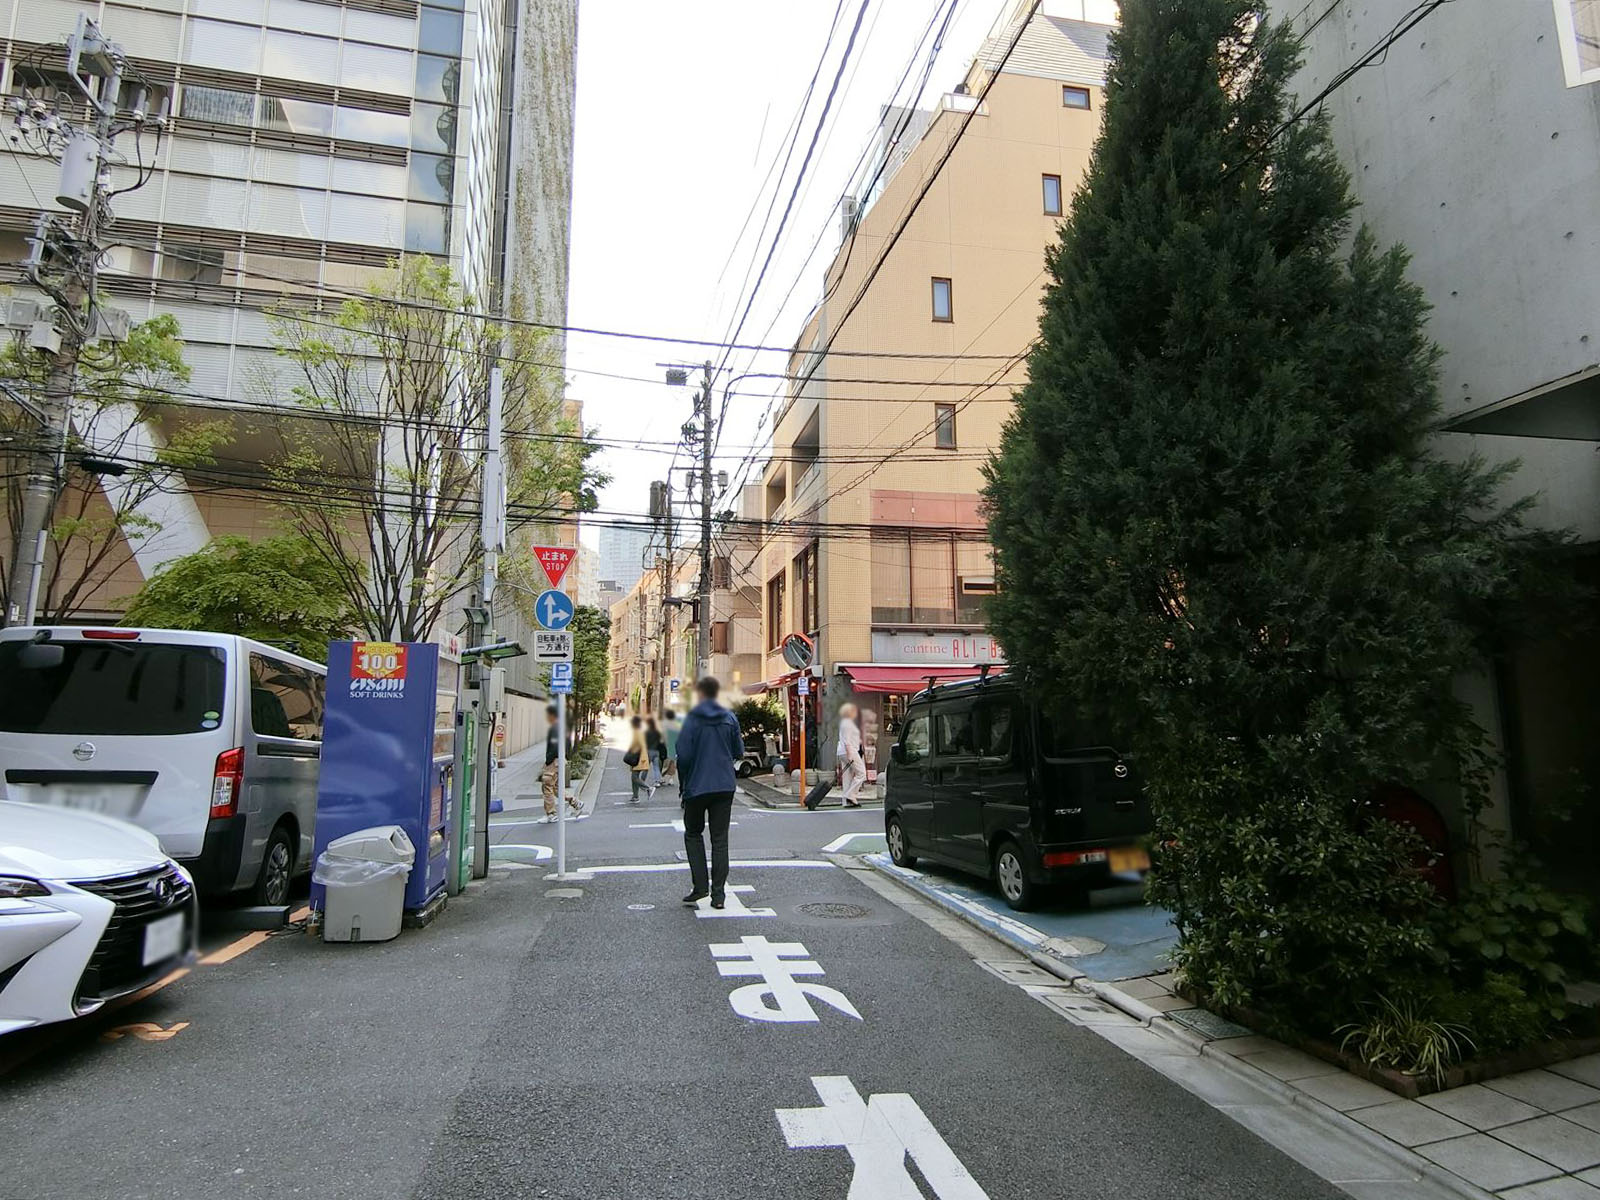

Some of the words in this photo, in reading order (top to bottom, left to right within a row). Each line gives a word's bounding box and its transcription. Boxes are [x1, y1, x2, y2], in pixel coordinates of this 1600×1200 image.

[541, 551, 568, 561] 止まれ
[546, 562, 566, 571] STOP
[537, 643, 570, 652] 一方通行
[359, 654, 397, 671] 100
[372, 691, 404, 699] DRINKS
